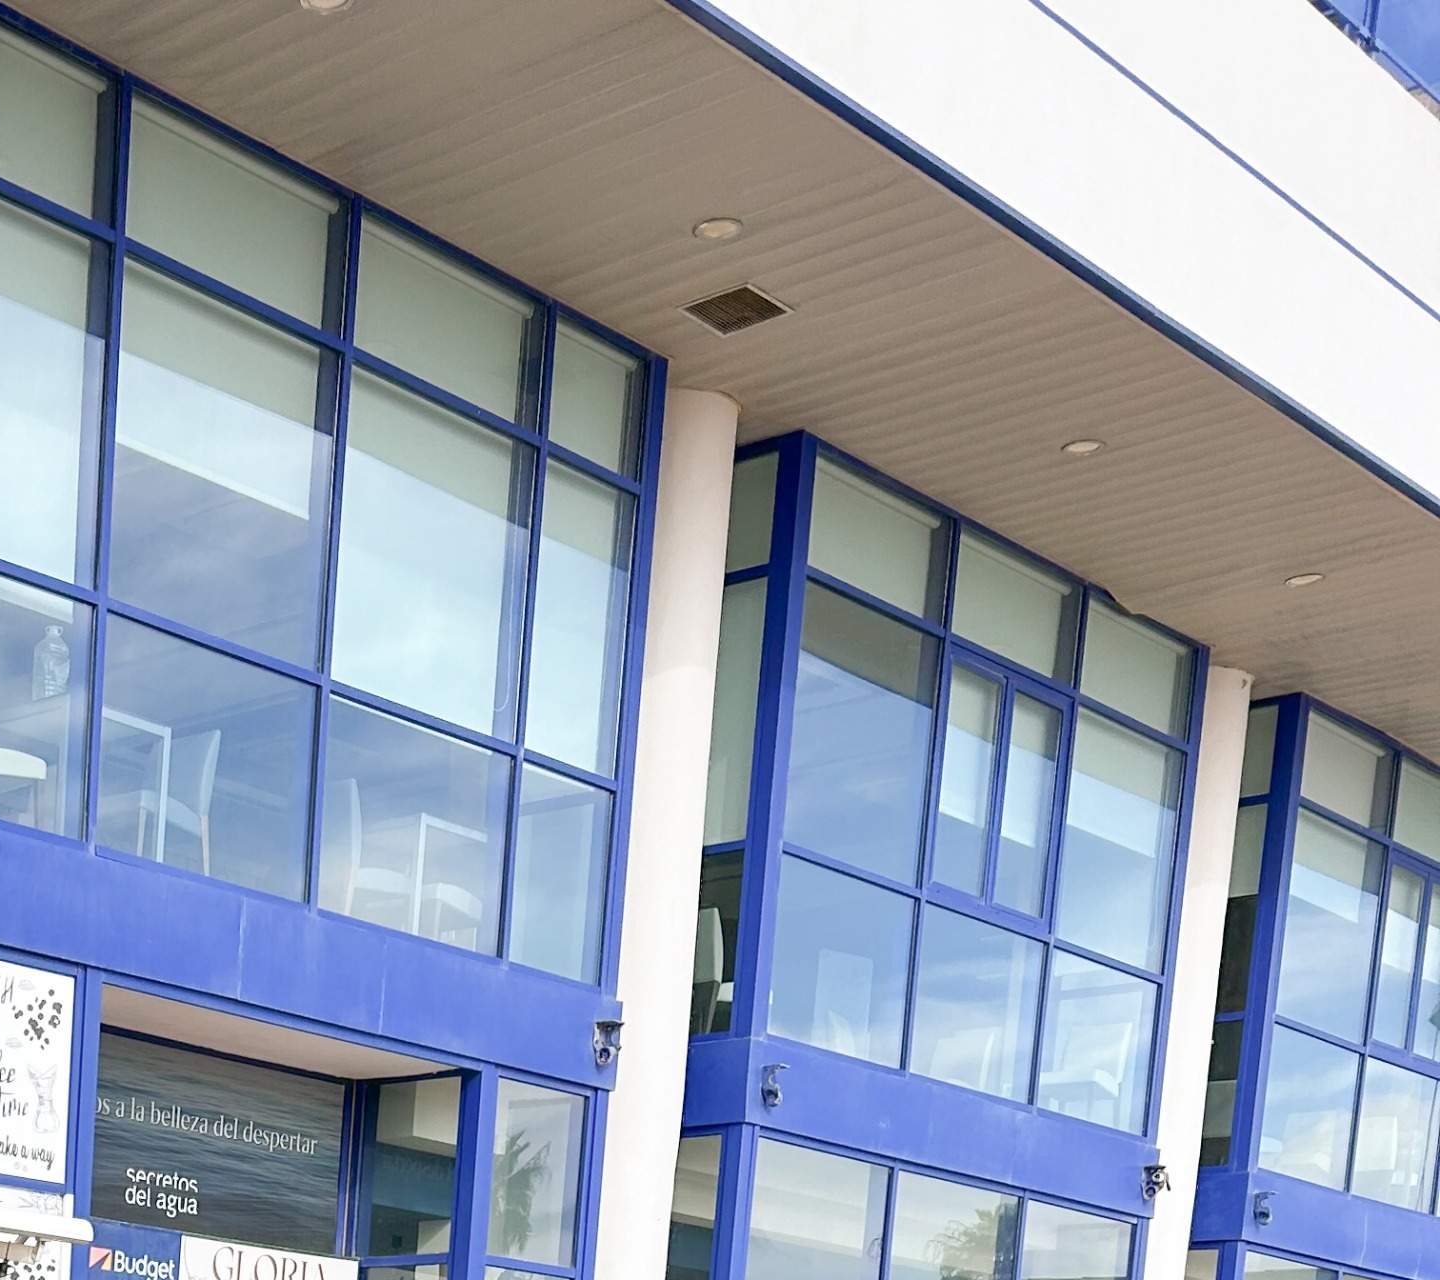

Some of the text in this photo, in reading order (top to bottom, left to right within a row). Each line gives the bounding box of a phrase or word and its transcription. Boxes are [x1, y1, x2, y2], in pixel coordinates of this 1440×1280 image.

[116, 1102, 125, 1117] a
[130, 1098, 146, 1122] la
[150, 1101, 208, 1133] belleza
[213, 1115, 239, 1141] del
[243, 1122, 318, 1155] despertar
[30, 1147, 55, 1171] way
[126, 1168, 199, 1193] secretos
[125, 1186, 198, 1217] del agua
